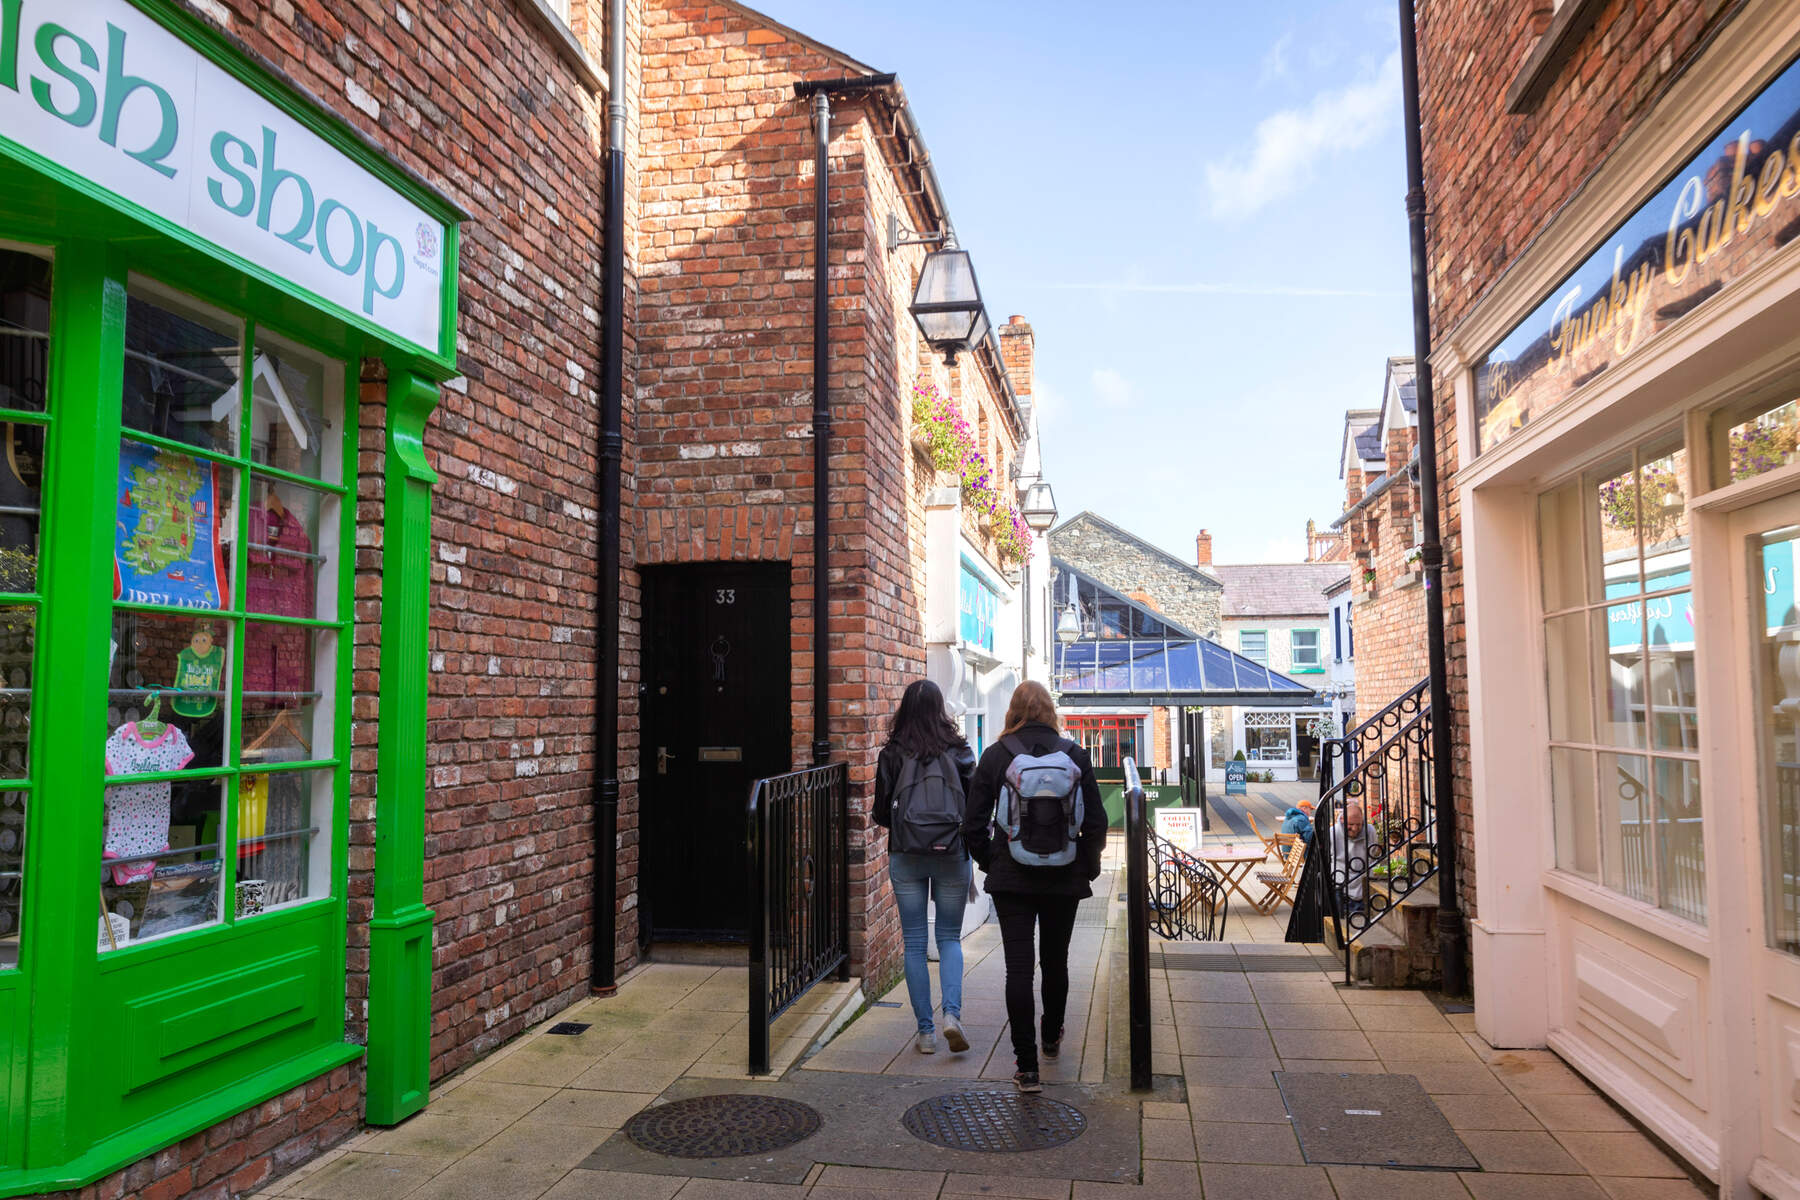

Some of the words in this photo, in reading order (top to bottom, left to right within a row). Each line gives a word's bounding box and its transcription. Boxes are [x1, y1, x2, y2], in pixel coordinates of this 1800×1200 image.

[207, 125, 404, 316] shop
[1548, 245, 1655, 376] Funky
[1666, 129, 1800, 287] Cakes
[716, 589, 735, 604] 33
[1228, 773, 1244, 782] OPEN
